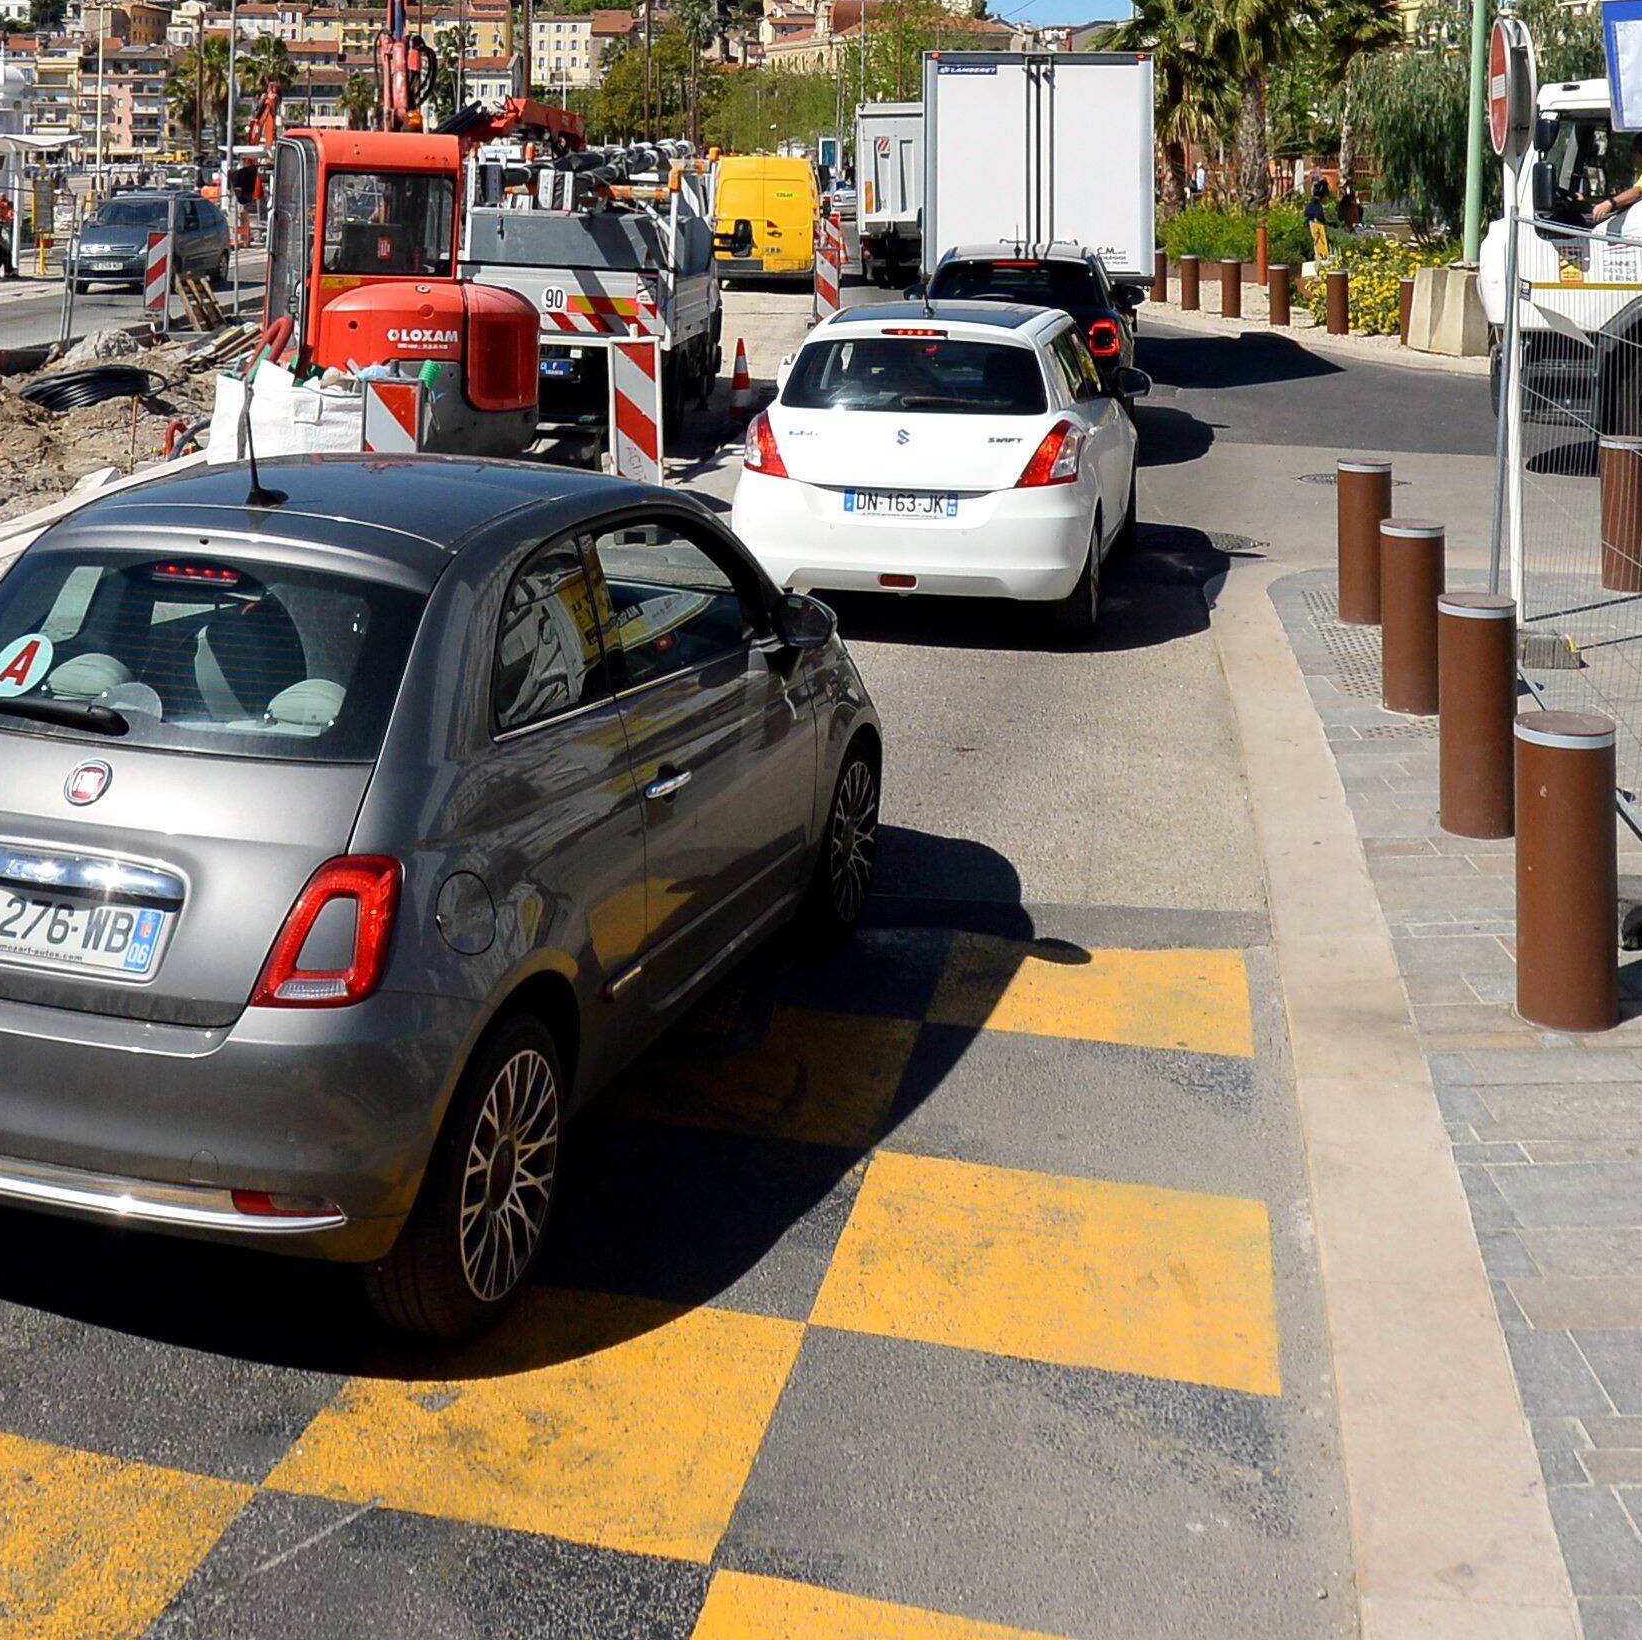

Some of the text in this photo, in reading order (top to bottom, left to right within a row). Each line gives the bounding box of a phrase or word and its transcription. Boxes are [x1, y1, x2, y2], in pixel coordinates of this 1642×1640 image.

[545, 288, 564, 309] 90
[400, 328, 459, 343] LOXAM
[855, 491, 945, 514] DN-163-JK
[127, 942, 149, 964] 06
